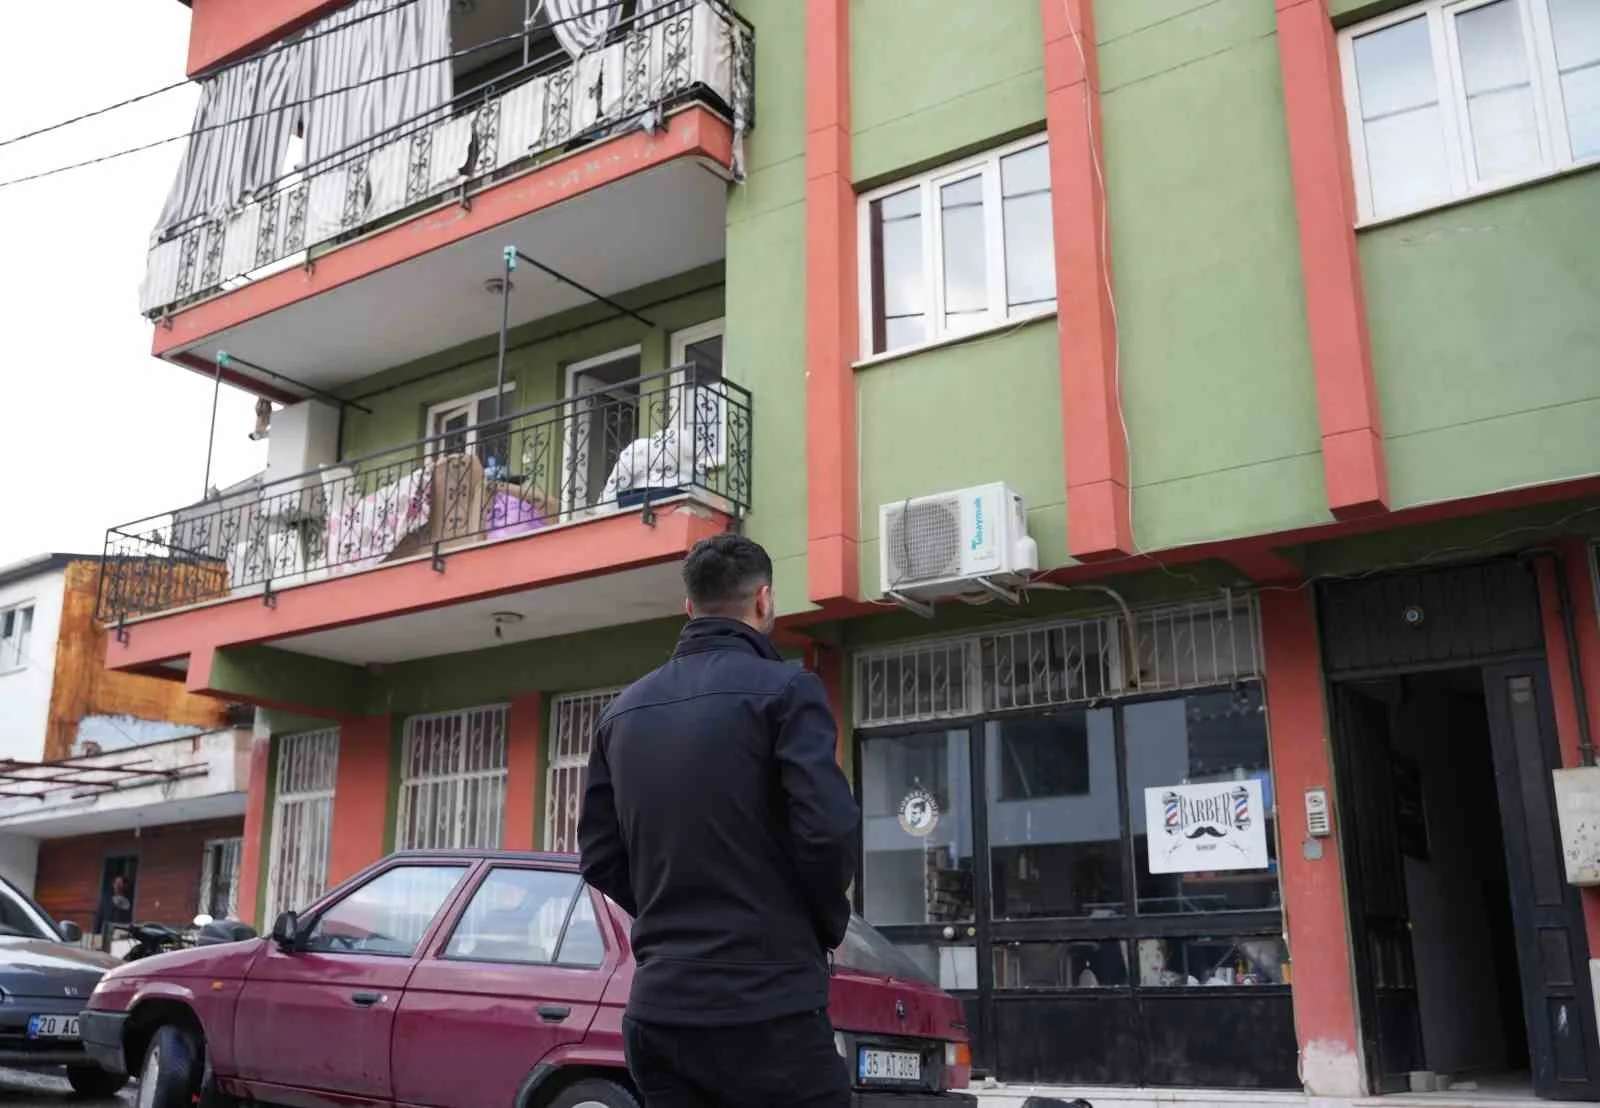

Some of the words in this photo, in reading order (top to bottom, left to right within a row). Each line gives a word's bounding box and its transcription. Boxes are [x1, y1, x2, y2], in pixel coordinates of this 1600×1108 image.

[1178, 792, 1233, 831] BARBER
[38, 1017, 57, 1034] 20
[867, 1053, 879, 1075] 35
[886, 1054, 897, 1076] AT
